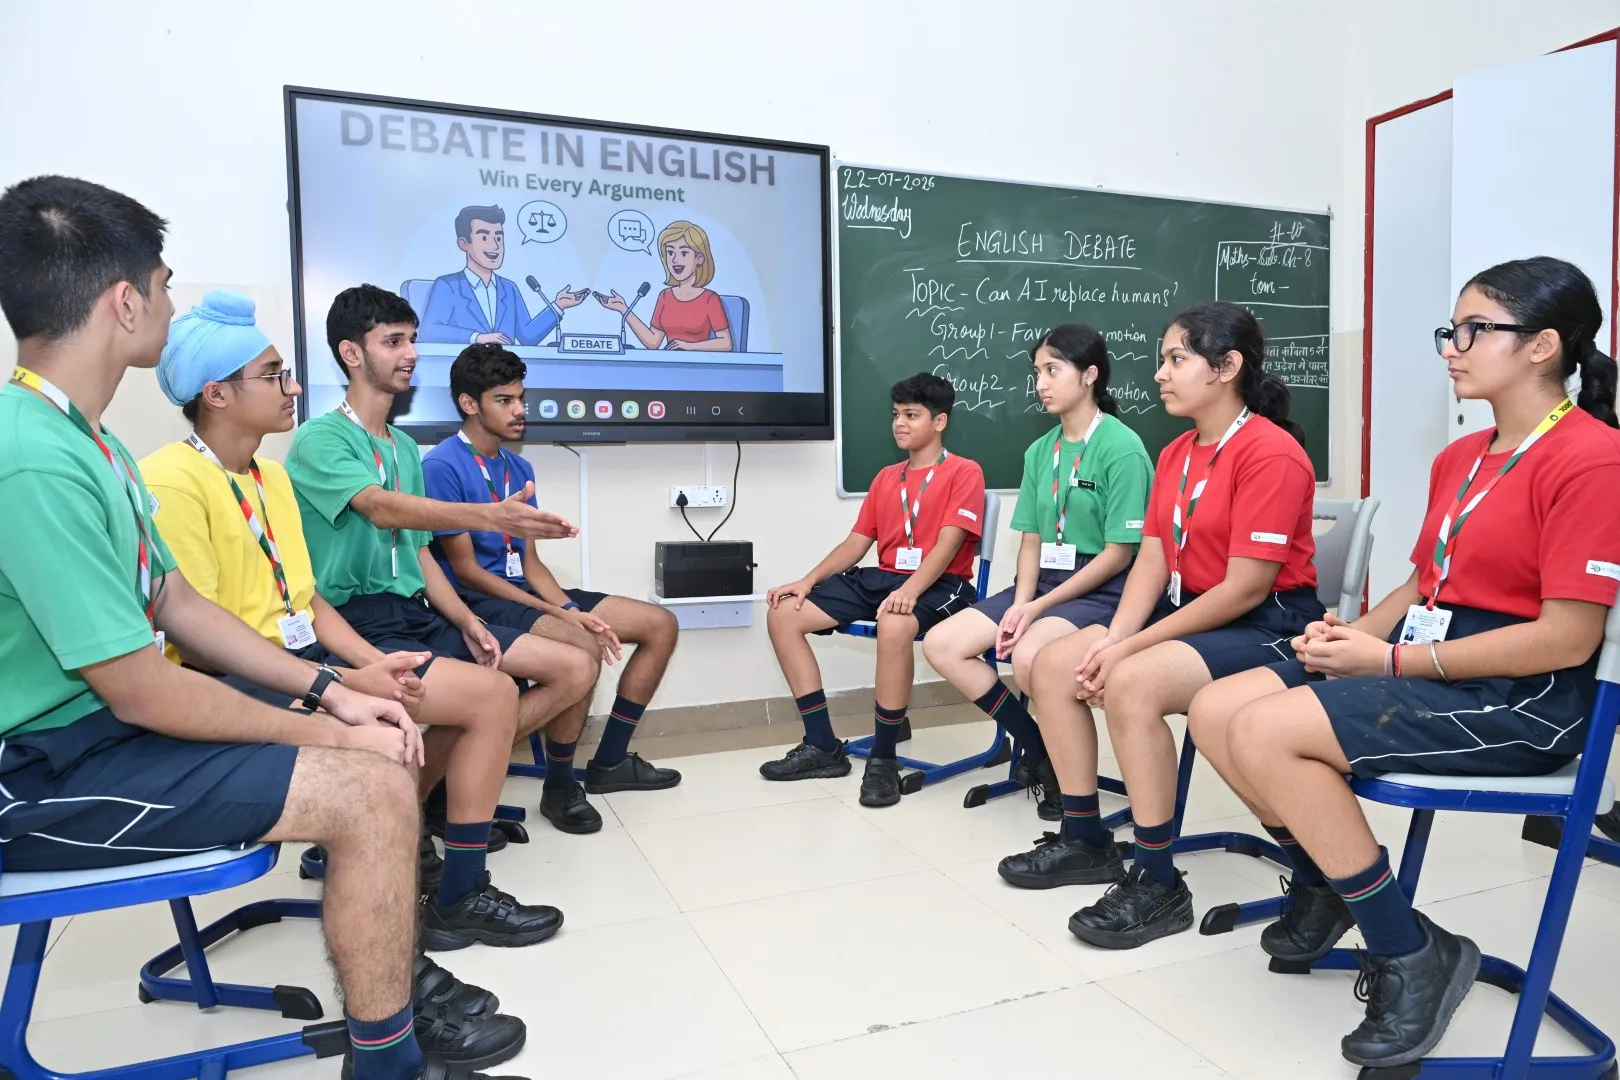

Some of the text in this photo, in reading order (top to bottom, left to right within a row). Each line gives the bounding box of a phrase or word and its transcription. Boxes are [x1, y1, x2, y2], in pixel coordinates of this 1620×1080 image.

[340, 108, 775, 186] DEBATE IN ENGLISH
[479, 168, 685, 203] Win Every Argument
[842, 192, 912, 239] Wednesday
[958, 221, 1136, 260] ENGLISH DEBATE
[975, 277, 1010, 305] Can
[1051, 280, 1106, 312] replace
[571, 339, 613, 349] DEBATE
[1105, 322, 1147, 343] motion
